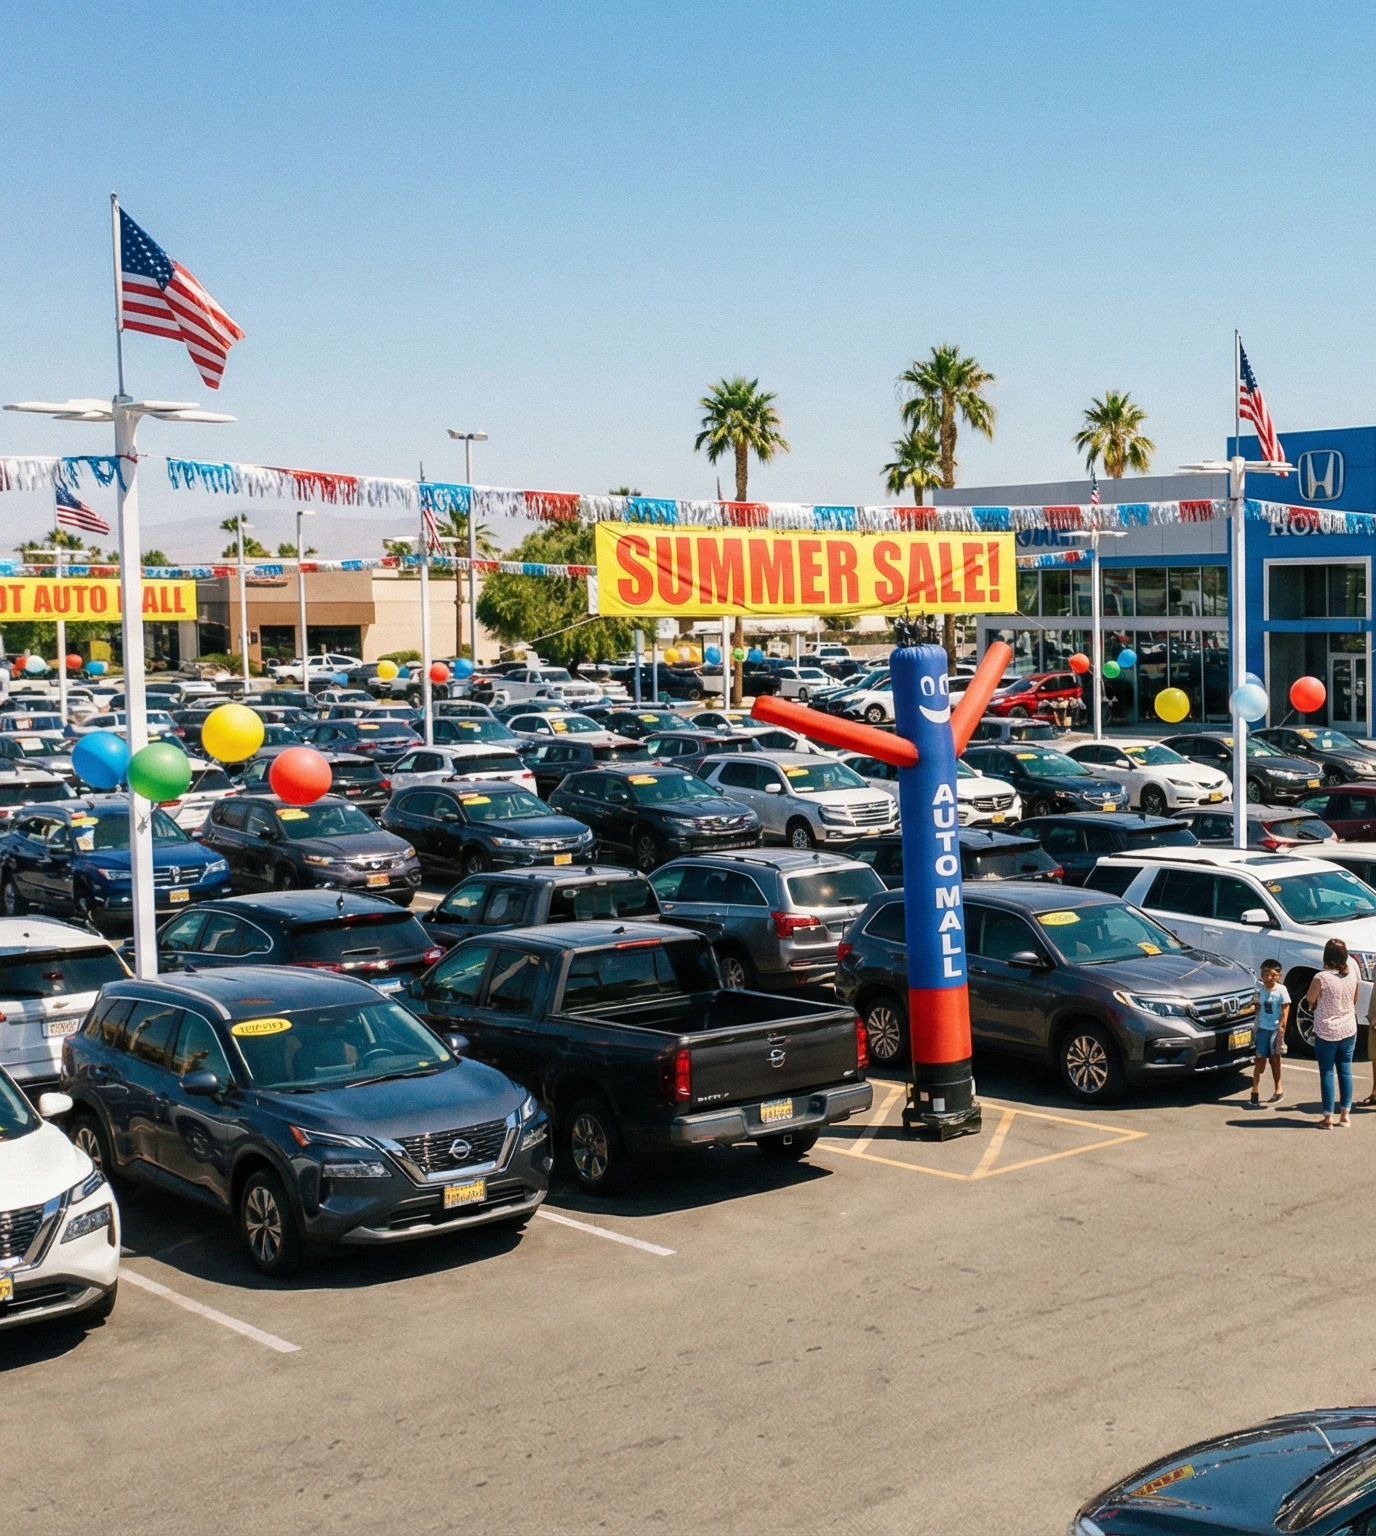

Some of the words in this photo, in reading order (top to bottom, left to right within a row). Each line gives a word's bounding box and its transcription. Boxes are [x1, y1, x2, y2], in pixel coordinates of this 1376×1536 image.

[33, 584, 108, 614] AUTO
[117, 585, 187, 614] ALL
[615, 534, 860, 607] SUMMER
[872, 540, 1001, 606] SALE!
[932, 783, 958, 877] AUTO
[935, 885, 963, 979] MALL
